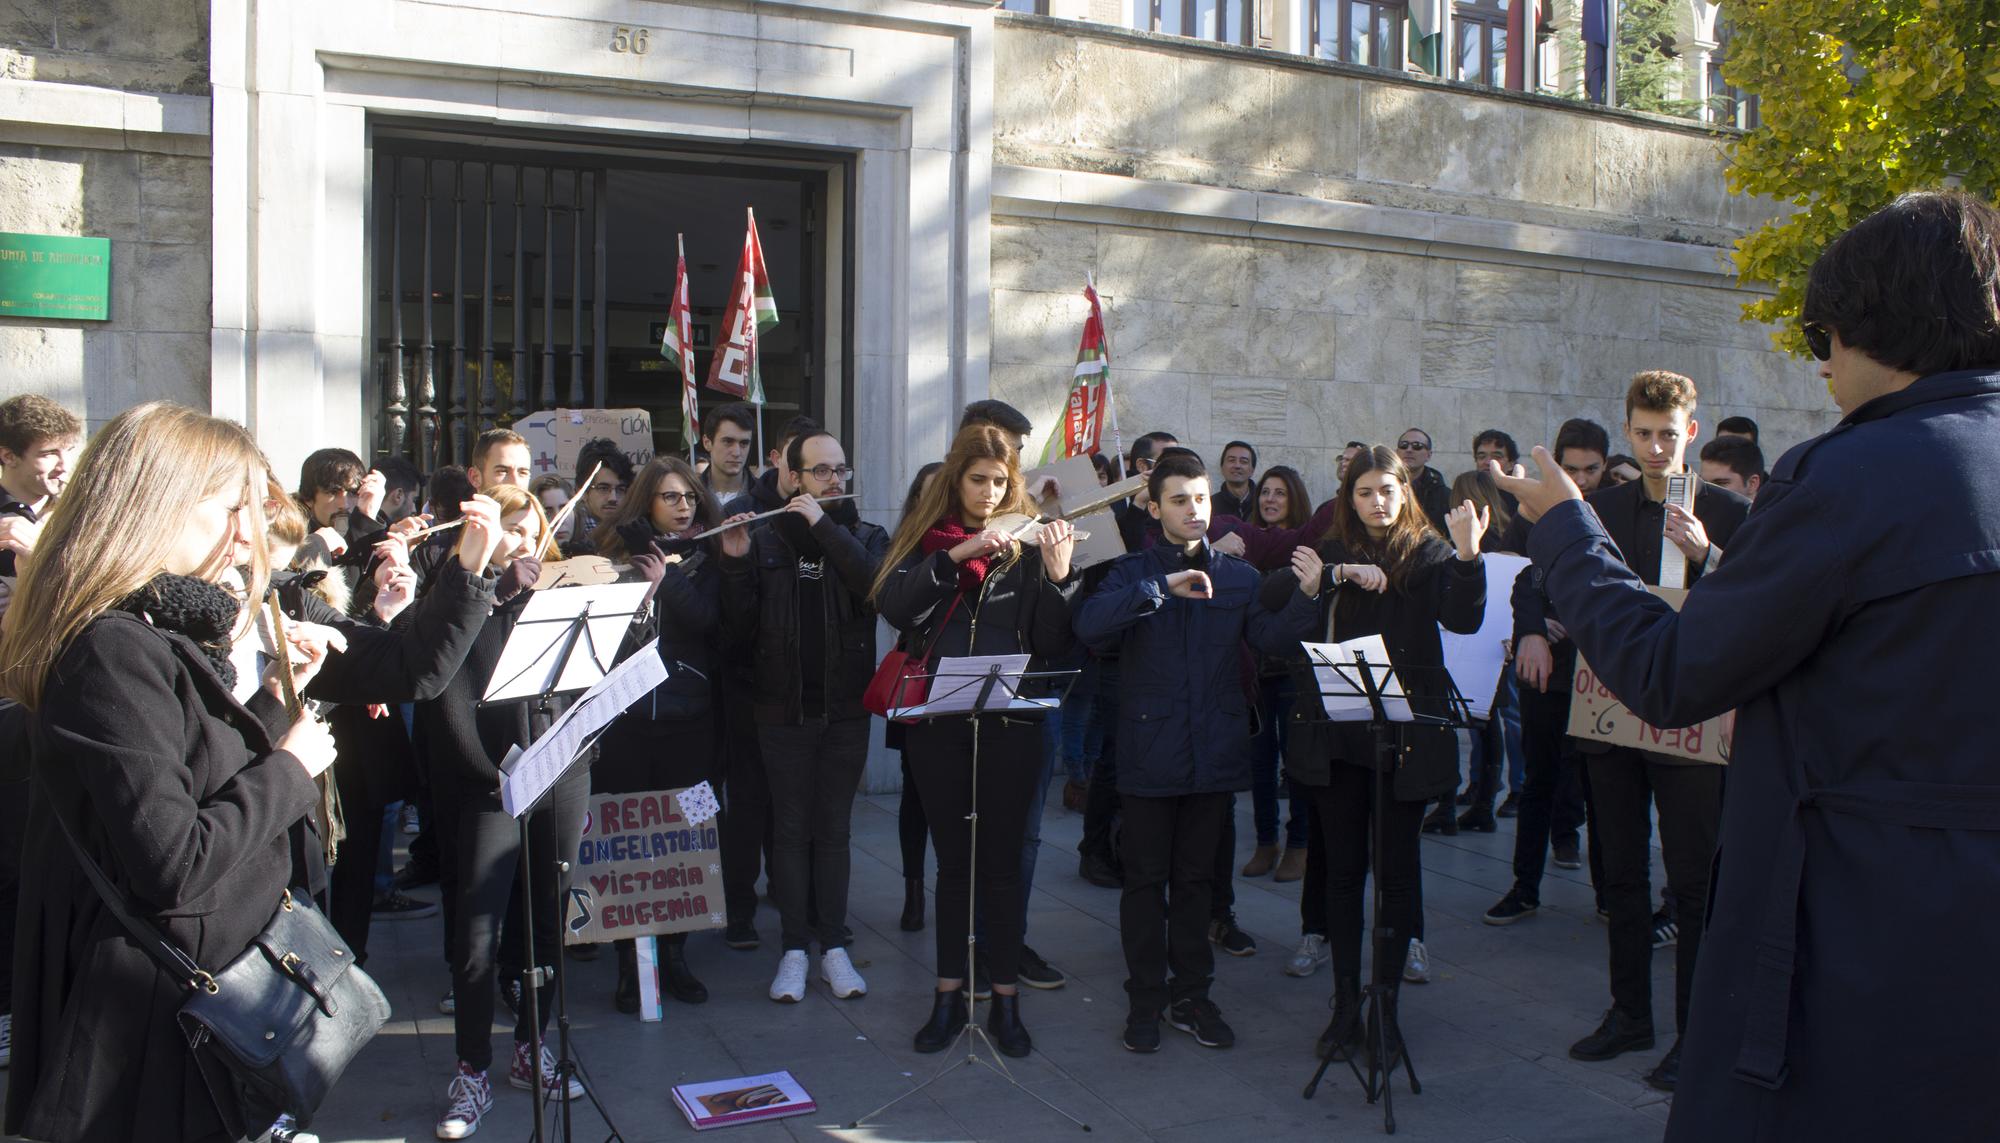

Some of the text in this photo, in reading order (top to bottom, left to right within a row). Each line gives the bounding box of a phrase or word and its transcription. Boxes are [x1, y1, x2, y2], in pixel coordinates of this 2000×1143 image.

[613, 25, 649, 54] 56
[32, 252, 45, 263] DE
[600, 795, 682, 835] REAL
[579, 823, 718, 865] ONGELATORIO
[590, 862, 704, 897] VICTORIA
[602, 891, 708, 929] EUGENIA
